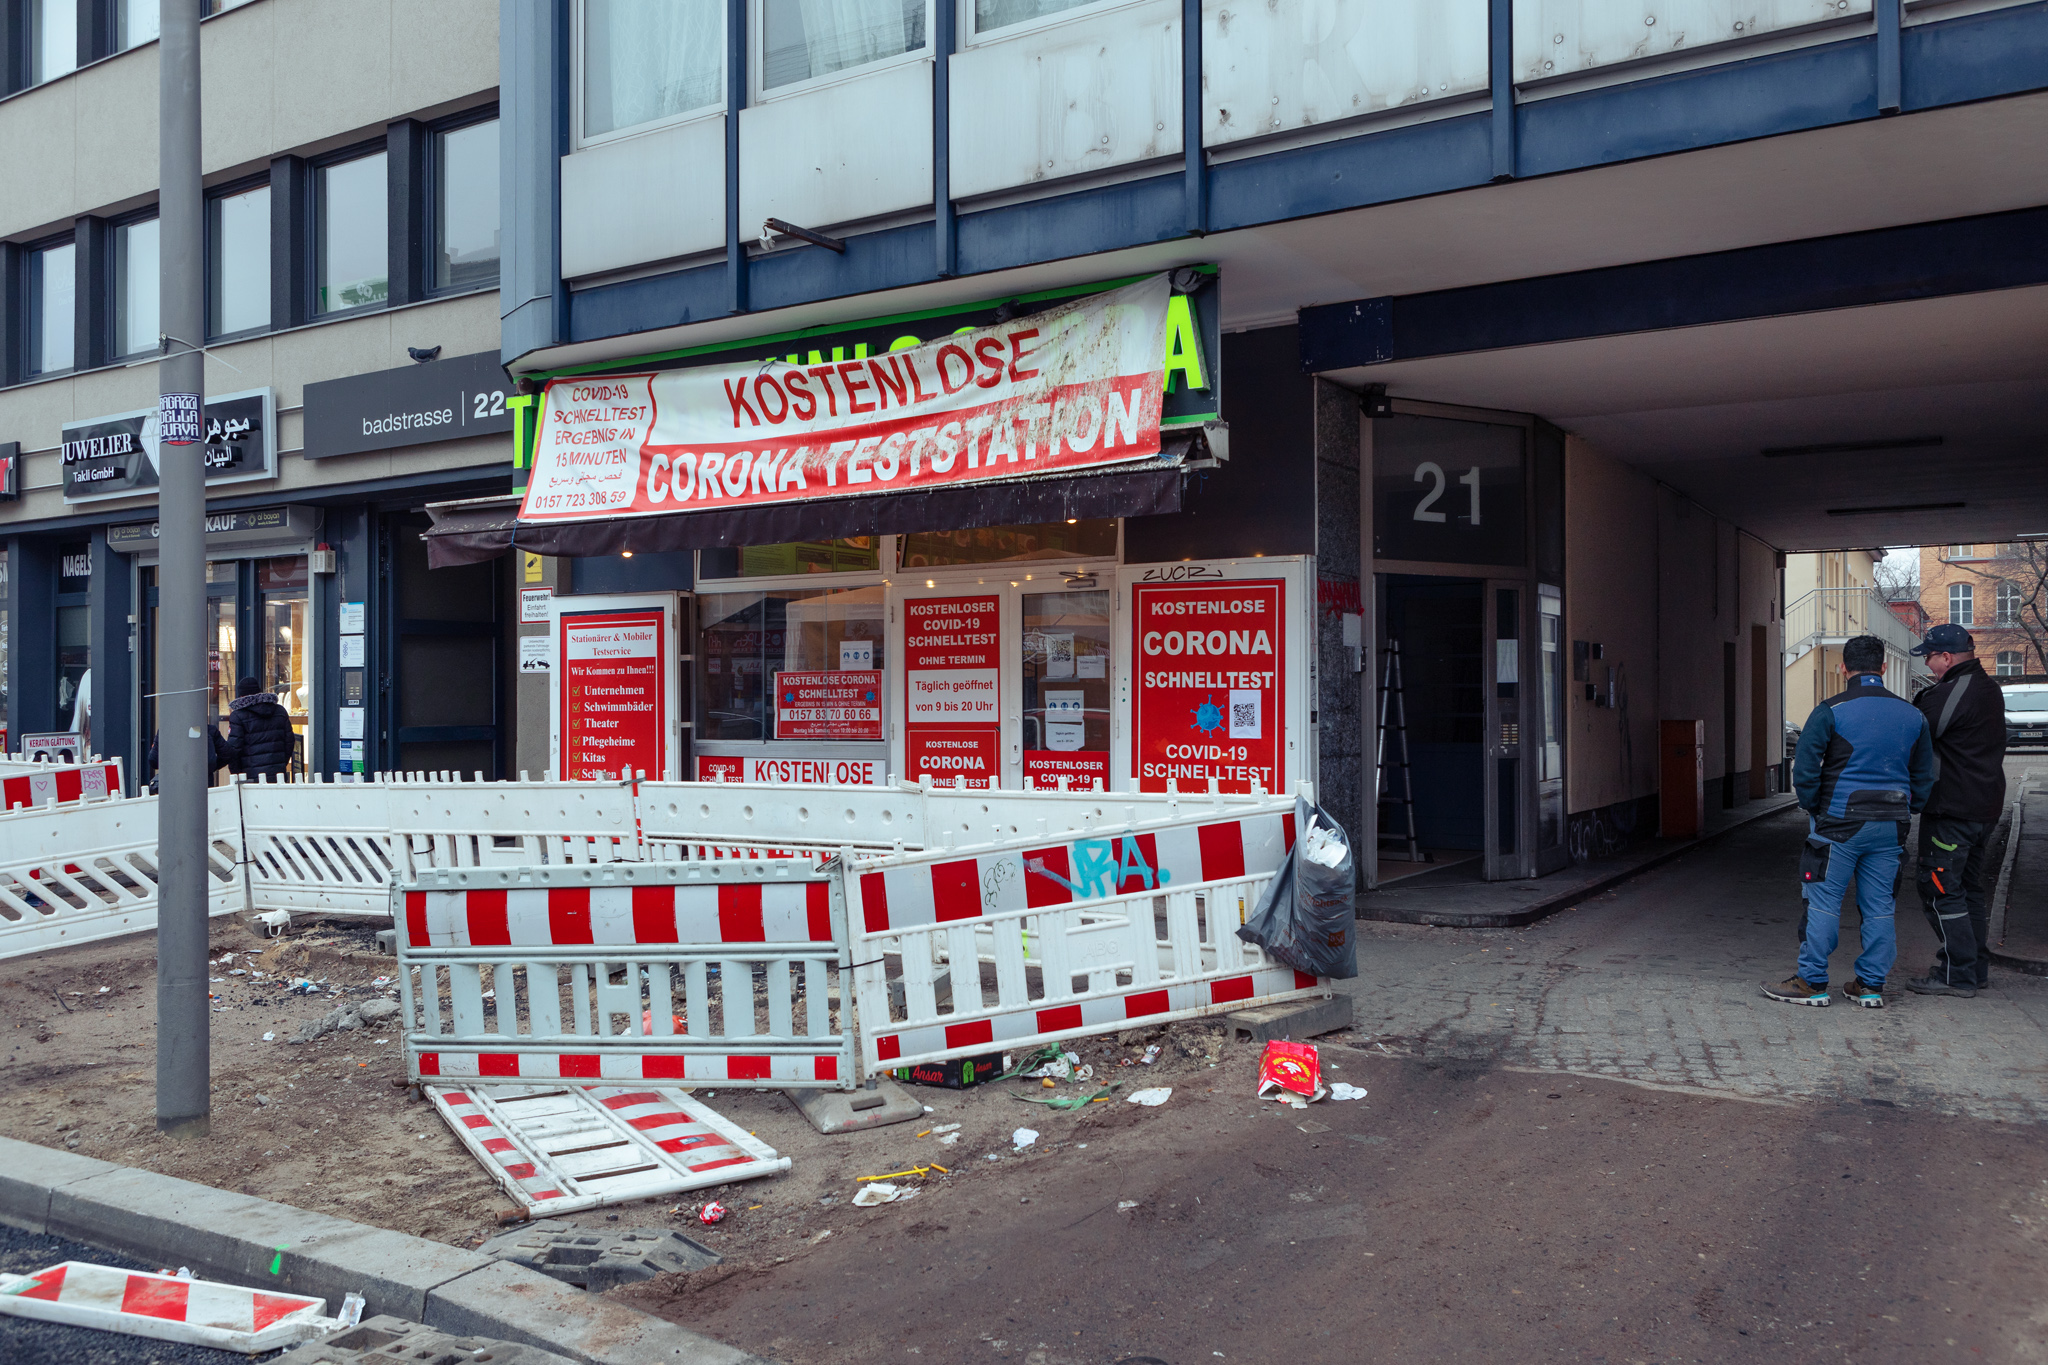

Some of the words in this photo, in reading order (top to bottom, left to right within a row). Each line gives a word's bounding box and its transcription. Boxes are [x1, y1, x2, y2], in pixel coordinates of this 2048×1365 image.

[723, 327, 1040, 428] KOSTENLOSE
[572, 384, 629, 402] COVID-19
[160, 410, 198, 423] DELLA
[362, 408, 453, 436] badstrasse
[474, 390, 505, 419] 22
[553, 406, 647, 425] SCHNELLTEST
[160, 423, 198, 436] CURVA
[555, 428, 617, 445] ERGEBNIS
[619, 427, 636, 441] IN
[59, 432, 133, 466] JUWELIER
[646, 446, 808, 503] CORONA
[825, 387, 1142, 487] TESTSTATION
[555, 453, 567, 468] 15
[569, 448, 627, 467] MINUTEN
[73, 469, 90, 483] Takli
[91, 466, 114, 480] GmbH
[598, 469, 623, 483] فحص
[535, 495, 563, 509] 0157
[566, 493, 585, 507] 723
[588, 491, 607, 506] 308
[610, 490, 627, 504] 59
[1413, 461, 1481, 525] 21
[910, 602, 995, 616] KOSTENLOSER
[1151, 600, 1266, 616] KOSTENLOSE
[923, 618, 980, 631] COVID-19
[571, 633, 612, 643] Stationärer
[613, 633, 620, 642] &
[623, 632, 653, 641] Mobiler
[908, 633, 997, 647] SCHNELLTEST
[1143, 630, 1273, 656] CORONA
[592, 646, 632, 656] Testservice
[918, 656, 946, 665] OHNE
[948, 655, 986, 664] TERMIN
[571, 667, 585, 676] Wir
[586, 666, 616, 676] Kommen
[617, 667, 625, 675] zu
[626, 665, 655, 675] Ihnen!!!
[783, 675, 840, 686] KOSTENLOSE
[841, 675, 877, 685] CORONA
[915, 680, 950, 693] Täglich
[952, 680, 994, 693] geöffnet
[1145, 671, 1274, 689] SCHNELLTEST
[584, 685, 645, 696] Unternehmen
[798, 688, 859, 699] SCHNELLTEST
[584, 701, 654, 712] Schwimmbäder
[915, 703, 933, 712] von
[935, 702, 942, 712] 9
[944, 702, 959, 712] bis
[961, 701, 973, 711] 20
[975, 701, 994, 711] Uhr
[789, 709, 812, 720] 0157
[815, 709, 827, 720] 83
[830, 709, 840, 719] 70
[844, 709, 856, 719] 60
[859, 709, 871, 719] 66
[584, 718, 620, 728] Theater
[50, 736, 75, 747] GLÄTTUNG
[582, 736, 636, 749] Pflegeheime
[925, 740, 979, 749] KOSTENLOSE
[582, 752, 606, 763] Kitas
[1165, 744, 1248, 761] COVID-19
[919, 755, 985, 770] CORONA
[1029, 760, 1104, 771] KOSTENLOSER
[582, 768, 617, 779] Schen
[1143, 763, 1272, 782] SCHNELLTEST
[912, 1065, 944, 1083] Ansar
[974, 1062, 993, 1073] Ansar
